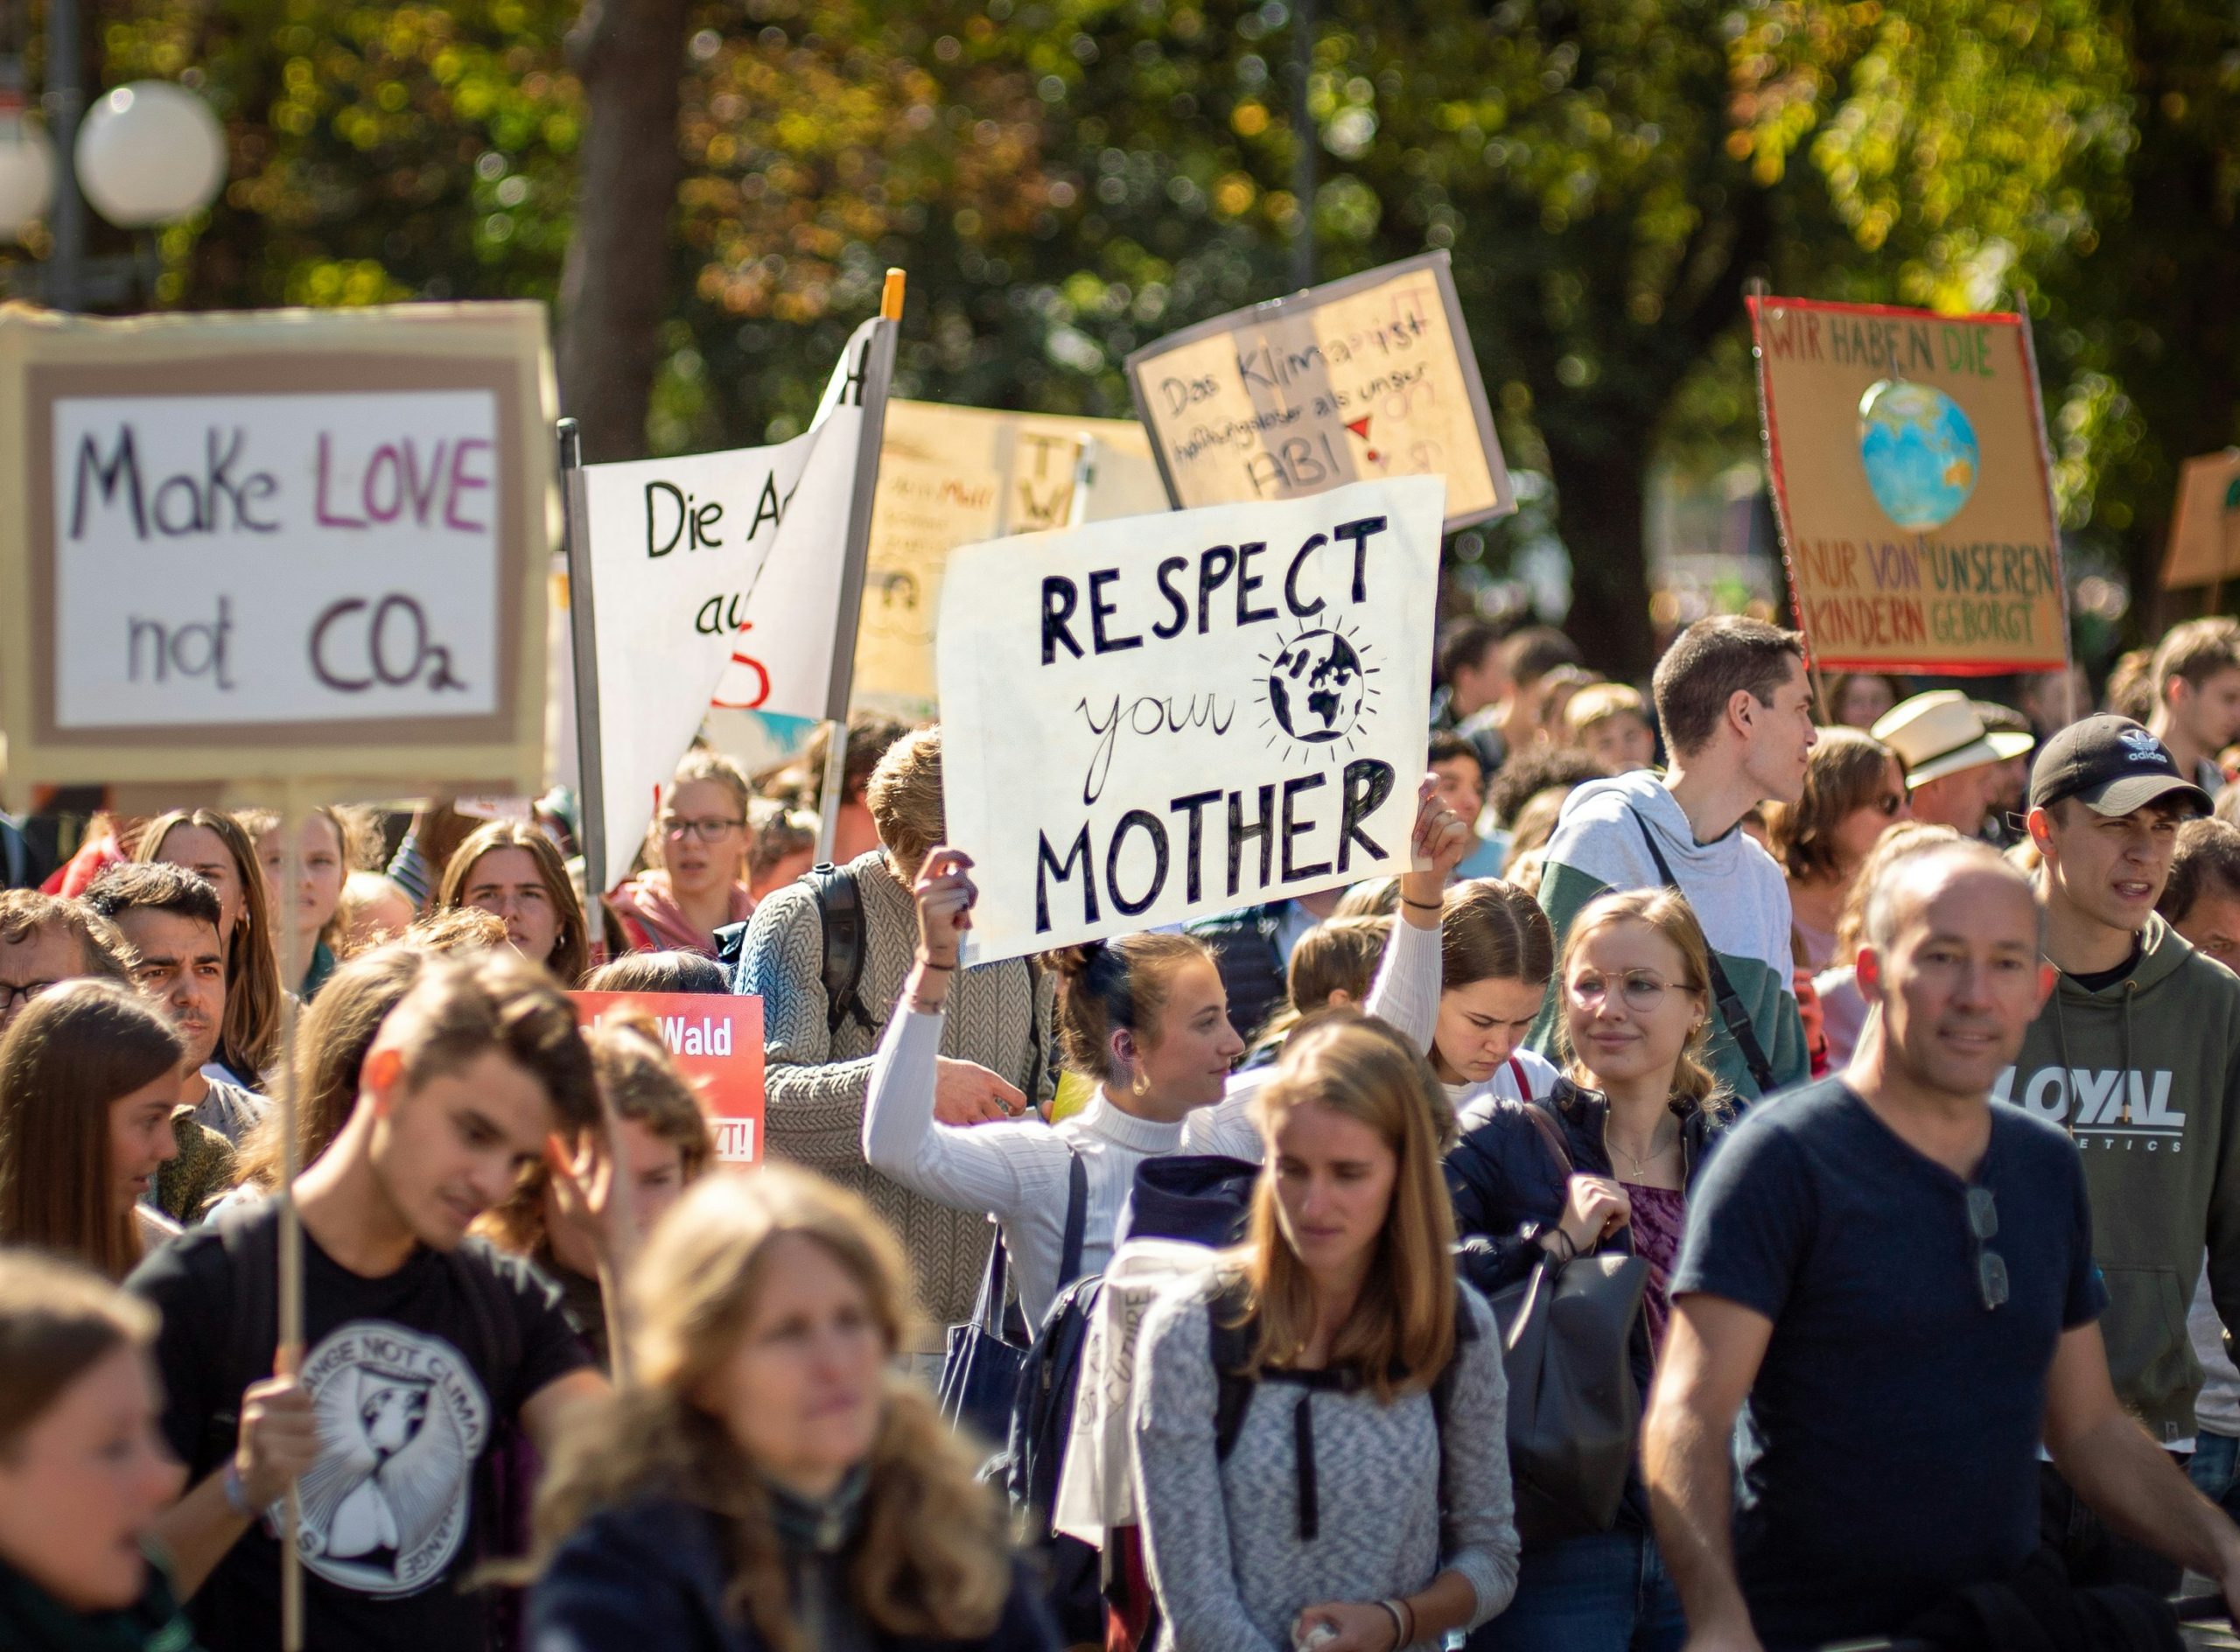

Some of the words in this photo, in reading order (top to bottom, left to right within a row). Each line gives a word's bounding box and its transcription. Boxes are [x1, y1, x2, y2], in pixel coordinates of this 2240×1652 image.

[1160, 373, 1220, 418] Das
[1236, 336, 1353, 397] Klima
[1763, 309, 1824, 360] WIR
[1830, 316, 1936, 373] HABEN
[1941, 324, 1995, 378] DIE
[1315, 389, 1350, 417] als
[68, 422, 281, 541] Make
[312, 430, 492, 536] LOVE
[645, 480, 723, 558] Die
[1040, 515, 1388, 666] RESPECT
[1799, 538, 1859, 589] NUR
[1865, 538, 1922, 590] VON
[1930, 542, 2056, 595] UNSEREN
[127, 592, 235, 691] not
[1807, 596, 1928, 646] KINDERN
[1075, 692, 1236, 805] your
[2128, 751, 2168, 764] adidas
[1035, 758, 1396, 934] MOTHER
[655, 1016, 732, 1056] Wald
[2079, 1138, 2182, 1152] ETICS
[361, 1335, 421, 1368] NOT
